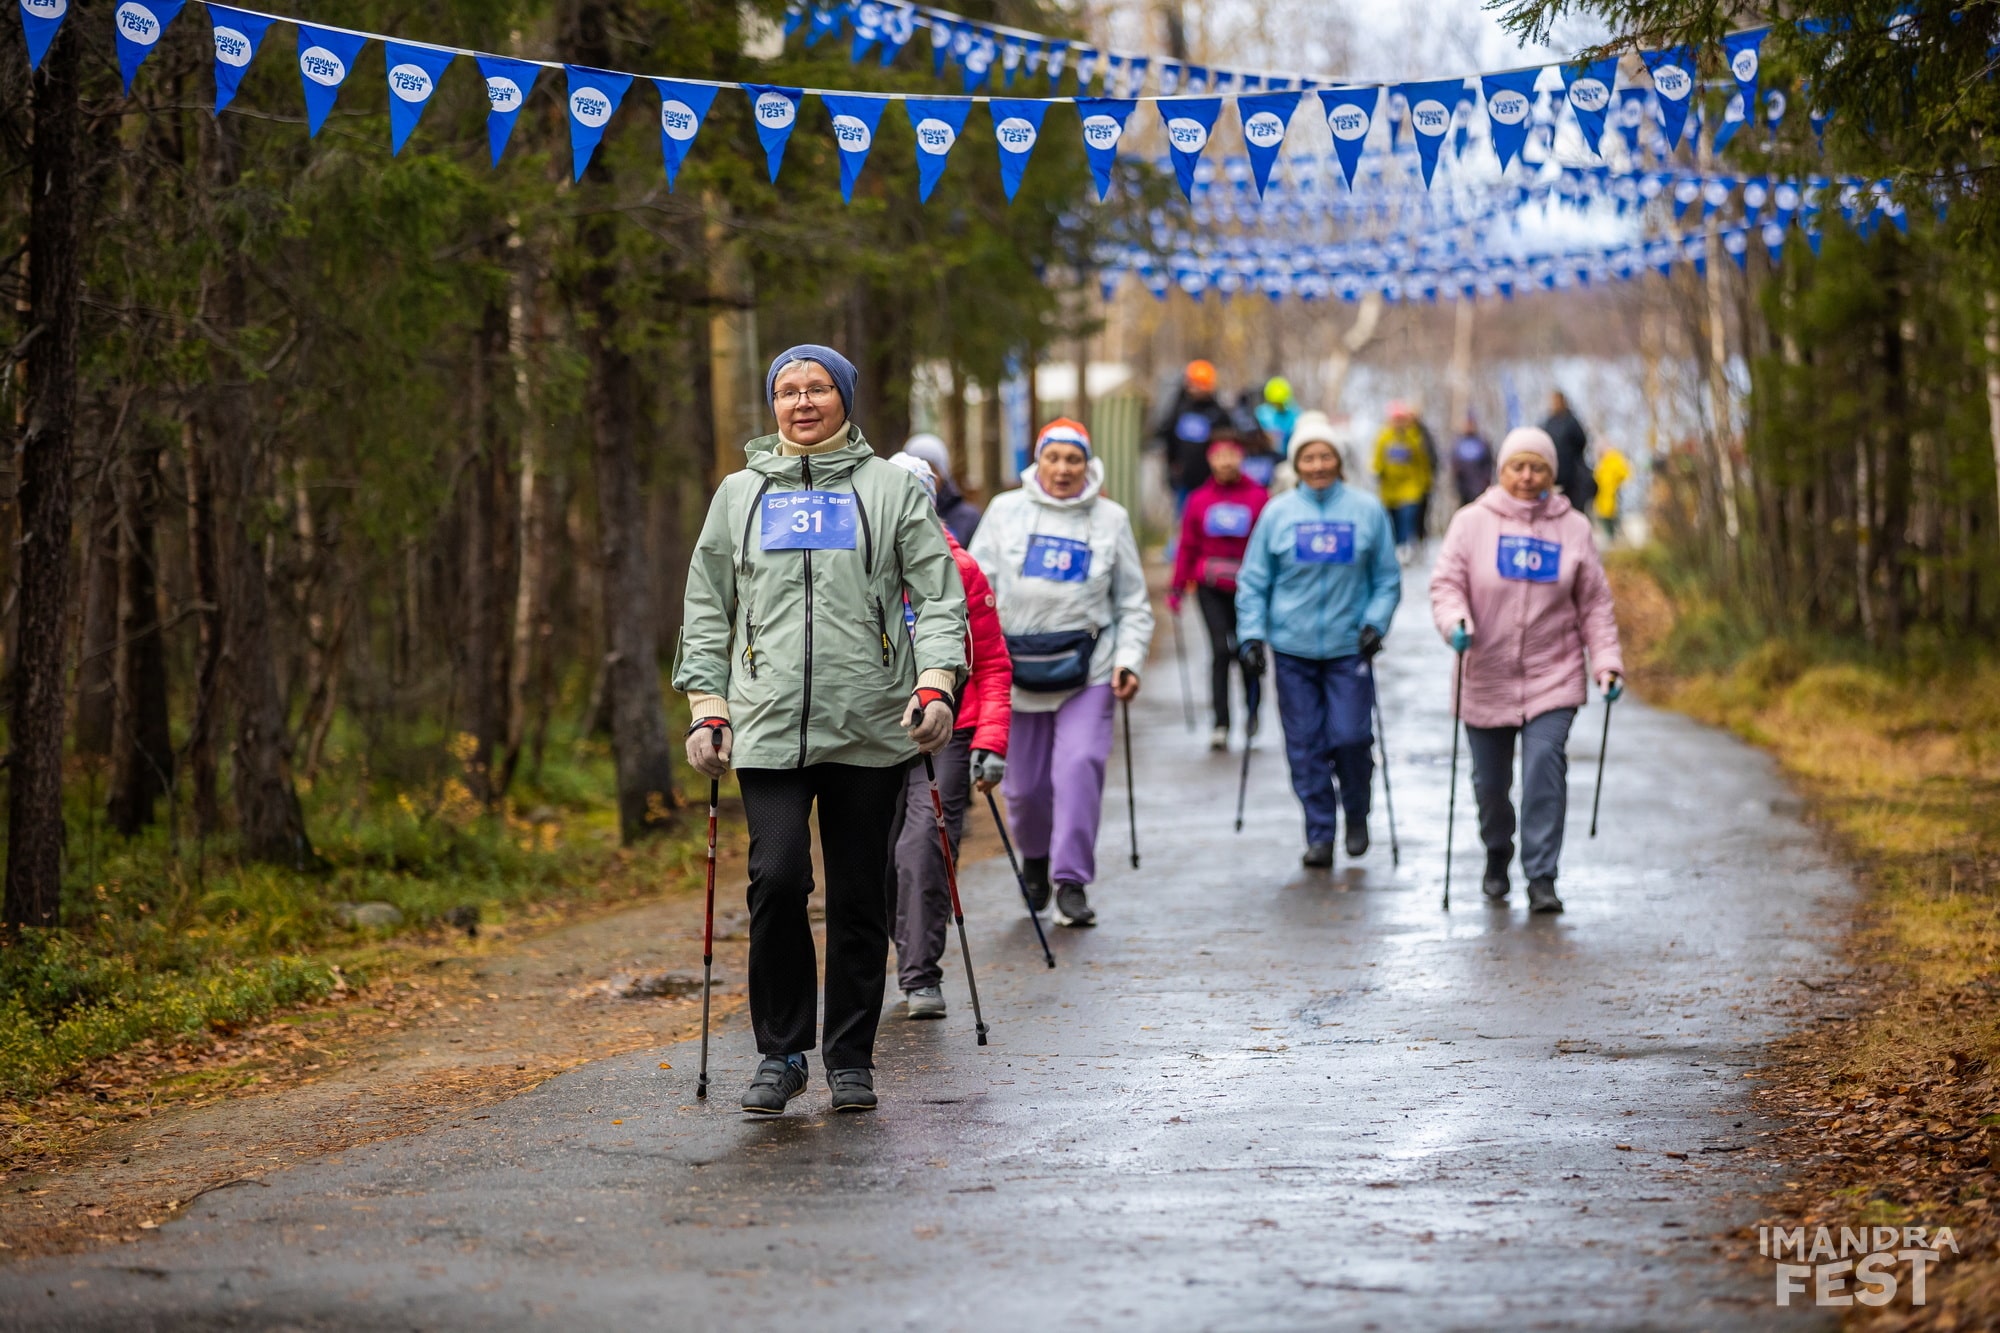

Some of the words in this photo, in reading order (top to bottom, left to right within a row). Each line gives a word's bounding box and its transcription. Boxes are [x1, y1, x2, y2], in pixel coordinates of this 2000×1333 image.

[791, 510, 822, 533] 31
[1311, 534, 1337, 553] 62
[1043, 548, 1072, 571] 58
[1513, 548, 1542, 571] 40
